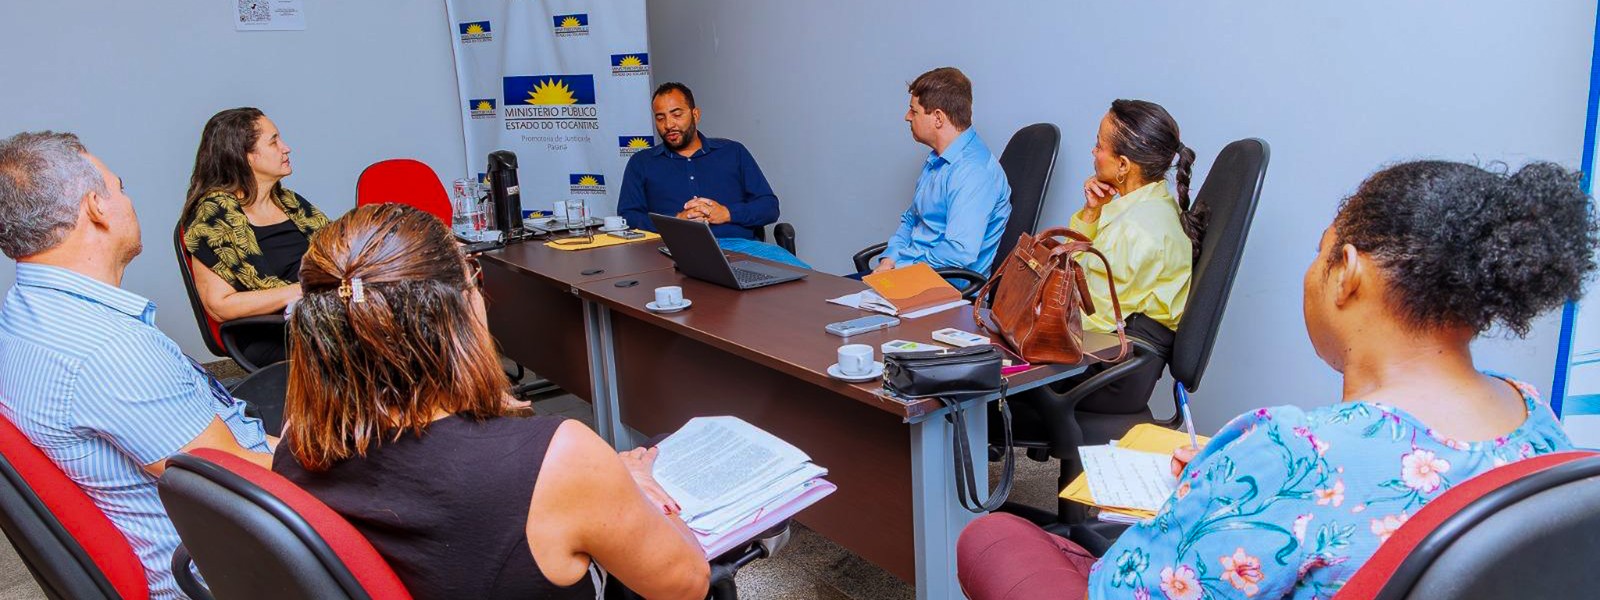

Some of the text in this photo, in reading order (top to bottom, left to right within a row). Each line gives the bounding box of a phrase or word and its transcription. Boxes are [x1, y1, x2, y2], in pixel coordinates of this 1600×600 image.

[505, 105, 559, 117] MINISTÉRIO
[561, 105, 597, 117] PÚBLICO
[505, 121, 599, 130] ESTADO DO TOCANTINS
